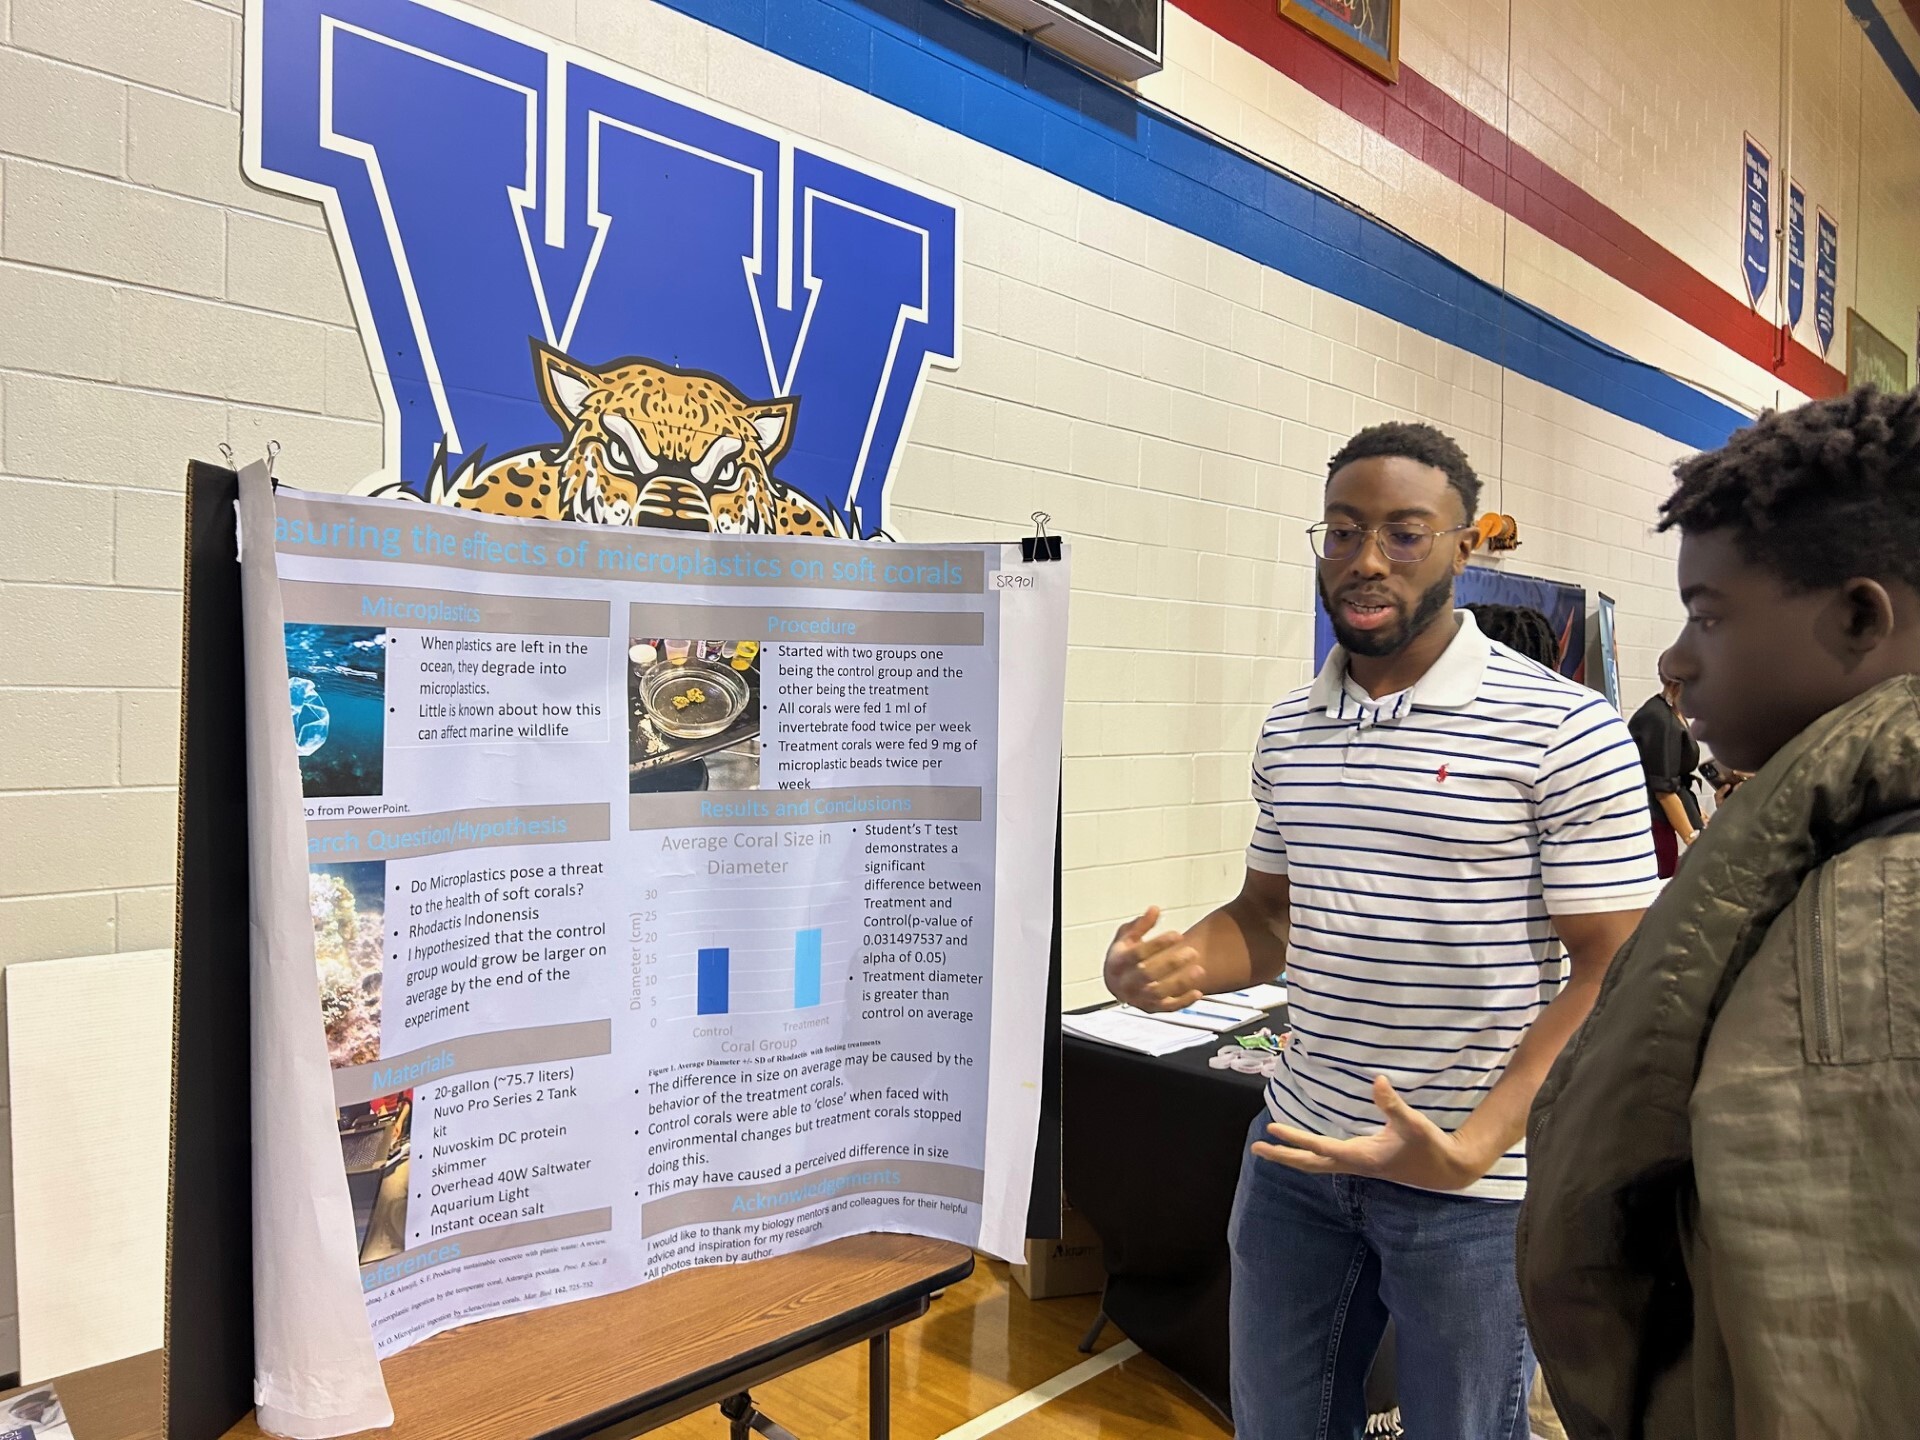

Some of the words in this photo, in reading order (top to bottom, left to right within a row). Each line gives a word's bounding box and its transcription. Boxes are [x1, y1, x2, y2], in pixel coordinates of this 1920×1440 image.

[243, 0, 962, 540] W
[411, 524, 457, 556] the
[461, 530, 547, 566] effects
[556, 540, 589, 568] of
[598, 545, 782, 580] microplastics
[790, 559, 824, 579] on
[833, 556, 875, 583] soft
[883, 560, 963, 585] corals
[996, 574, 1034, 588] SR901
[361, 595, 480, 624] Microplastics
[767, 615, 856, 636] Procedure
[421, 636, 453, 650] When
[456, 638, 492, 653] plastics
[496, 642, 516, 652] are
[521, 640, 544, 653] left
[549, 641, 561, 654] in
[565, 642, 588, 654] the
[778, 645, 823, 657] Started
[826, 646, 849, 658] with
[852, 648, 873, 658] two
[875, 650, 917, 662] groups
[920, 651, 943, 660] one
[420, 662, 455, 674] ocean,
[458, 660, 479, 676] they
[481, 660, 535, 676] degrade
[540, 662, 566, 674] into
[779, 664, 813, 679] being
[816, 664, 835, 676] the
[837, 665, 874, 677] control
[878, 668, 913, 680] group
[916, 666, 939, 678] and
[943, 667, 963, 678] the
[420, 681, 489, 697] microplastics.
[779, 683, 813, 695] other
[817, 683, 846, 697] being
[848, 683, 866, 695] the
[869, 685, 928, 695] treatment
[420, 703, 446, 717] Little
[449, 704, 456, 717] is
[458, 703, 494, 716] known
[498, 703, 538, 716] about
[542, 703, 572, 716] how
[576, 703, 601, 715] this
[418, 729, 437, 740] can
[441, 725, 467, 739] affect
[470, 724, 514, 737] marine
[518, 723, 569, 737] wildlife
[318, 805, 344, 816] from
[348, 804, 409, 815] PowerPoint.
[700, 800, 769, 817] Results
[775, 800, 810, 816] and
[813, 798, 912, 815] Conclusions
[367, 816, 567, 852] Question/Hypothesis
[924, 824, 932, 835] T
[935, 825, 958, 835] test
[662, 836, 728, 852] Average
[734, 832, 778, 848] Coral
[784, 831, 814, 847] Size
[819, 830, 831, 844] in
[865, 842, 947, 854] demonstrates
[951, 845, 958, 853] a
[708, 860, 788, 874] Diameter
[865, 859, 925, 874] significant
[411, 880, 427, 893] Do
[430, 868, 506, 890] Microplastics
[510, 868, 544, 882] pose
[548, 867, 556, 876] a
[561, 862, 603, 876] threat
[865, 878, 925, 890] difference
[928, 878, 981, 891] between
[410, 904, 422, 916] to
[425, 899, 443, 913] the
[446, 891, 480, 908] health
[484, 888, 499, 902] of
[503, 886, 530, 901] soft
[534, 883, 584, 899] corals?
[645, 889, 657, 900] 30
[864, 898, 926, 908] Treatment
[929, 897, 952, 908] and
[409, 916, 461, 938] Rhodactis
[465, 907, 539, 926] Indonensis
[645, 910, 657, 922] 25
[960, 916, 973, 927] of
[629, 912, 643, 943] (cm)
[645, 932, 658, 943] 20
[863, 933, 943, 946] 0.031497537
[945, 935, 967, 946] and
[646, 953, 657, 964] 15
[630, 953, 641, 1010] Diameter
[645, 975, 657, 986] 10
[651, 996, 656, 1006] 5
[650, 1018, 657, 1028] 0
[783, 1016, 829, 1032] Treatment
[693, 1025, 733, 1038] Control
[721, 1040, 755, 1053] Coral
[759, 1038, 797, 1051] Group
[372, 1051, 454, 1090] Materials
[648, 1081, 669, 1095] The
[672, 1074, 736, 1089] difference
[741, 1071, 752, 1083] in
[756, 1070, 780, 1082] size
[783, 1068, 798, 1079] on
[801, 1059, 842, 1075] average
[845, 1055, 869, 1066] may
[872, 1051, 887, 1062] be
[890, 1051, 932, 1063] caused
[937, 1051, 951, 1066] by
[954, 1053, 973, 1066] the
[434, 1080, 490, 1100] 20-gallon
[494, 1072, 534, 1090] (~75.7
[539, 1066, 574, 1082] liters)
[434, 1104, 464, 1119] Nuvo
[468, 1099, 489, 1111] Pro
[493, 1092, 532, 1107] Series
[536, 1090, 543, 1101] 2
[547, 1085, 577, 1099] Tank
[433, 1136, 494, 1158] Nuvoskim
[499, 1131, 516, 1144] DC
[521, 1125, 566, 1144] protein
[431, 1173, 493, 1198] Overhead
[497, 1168, 528, 1183] 40W
[532, 1160, 591, 1178] Saltwater
[731, 1168, 901, 1213] Acknowledgements
[431, 1195, 494, 1216] Aquarium
[499, 1187, 529, 1203] Light
[431, 1216, 474, 1236] Instant
[478, 1209, 518, 1224] ocean
[522, 1203, 544, 1217] salt
[661, 1258, 691, 1276] photos
[694, 1255, 723, 1265] taken
[725, 1253, 738, 1264] by
